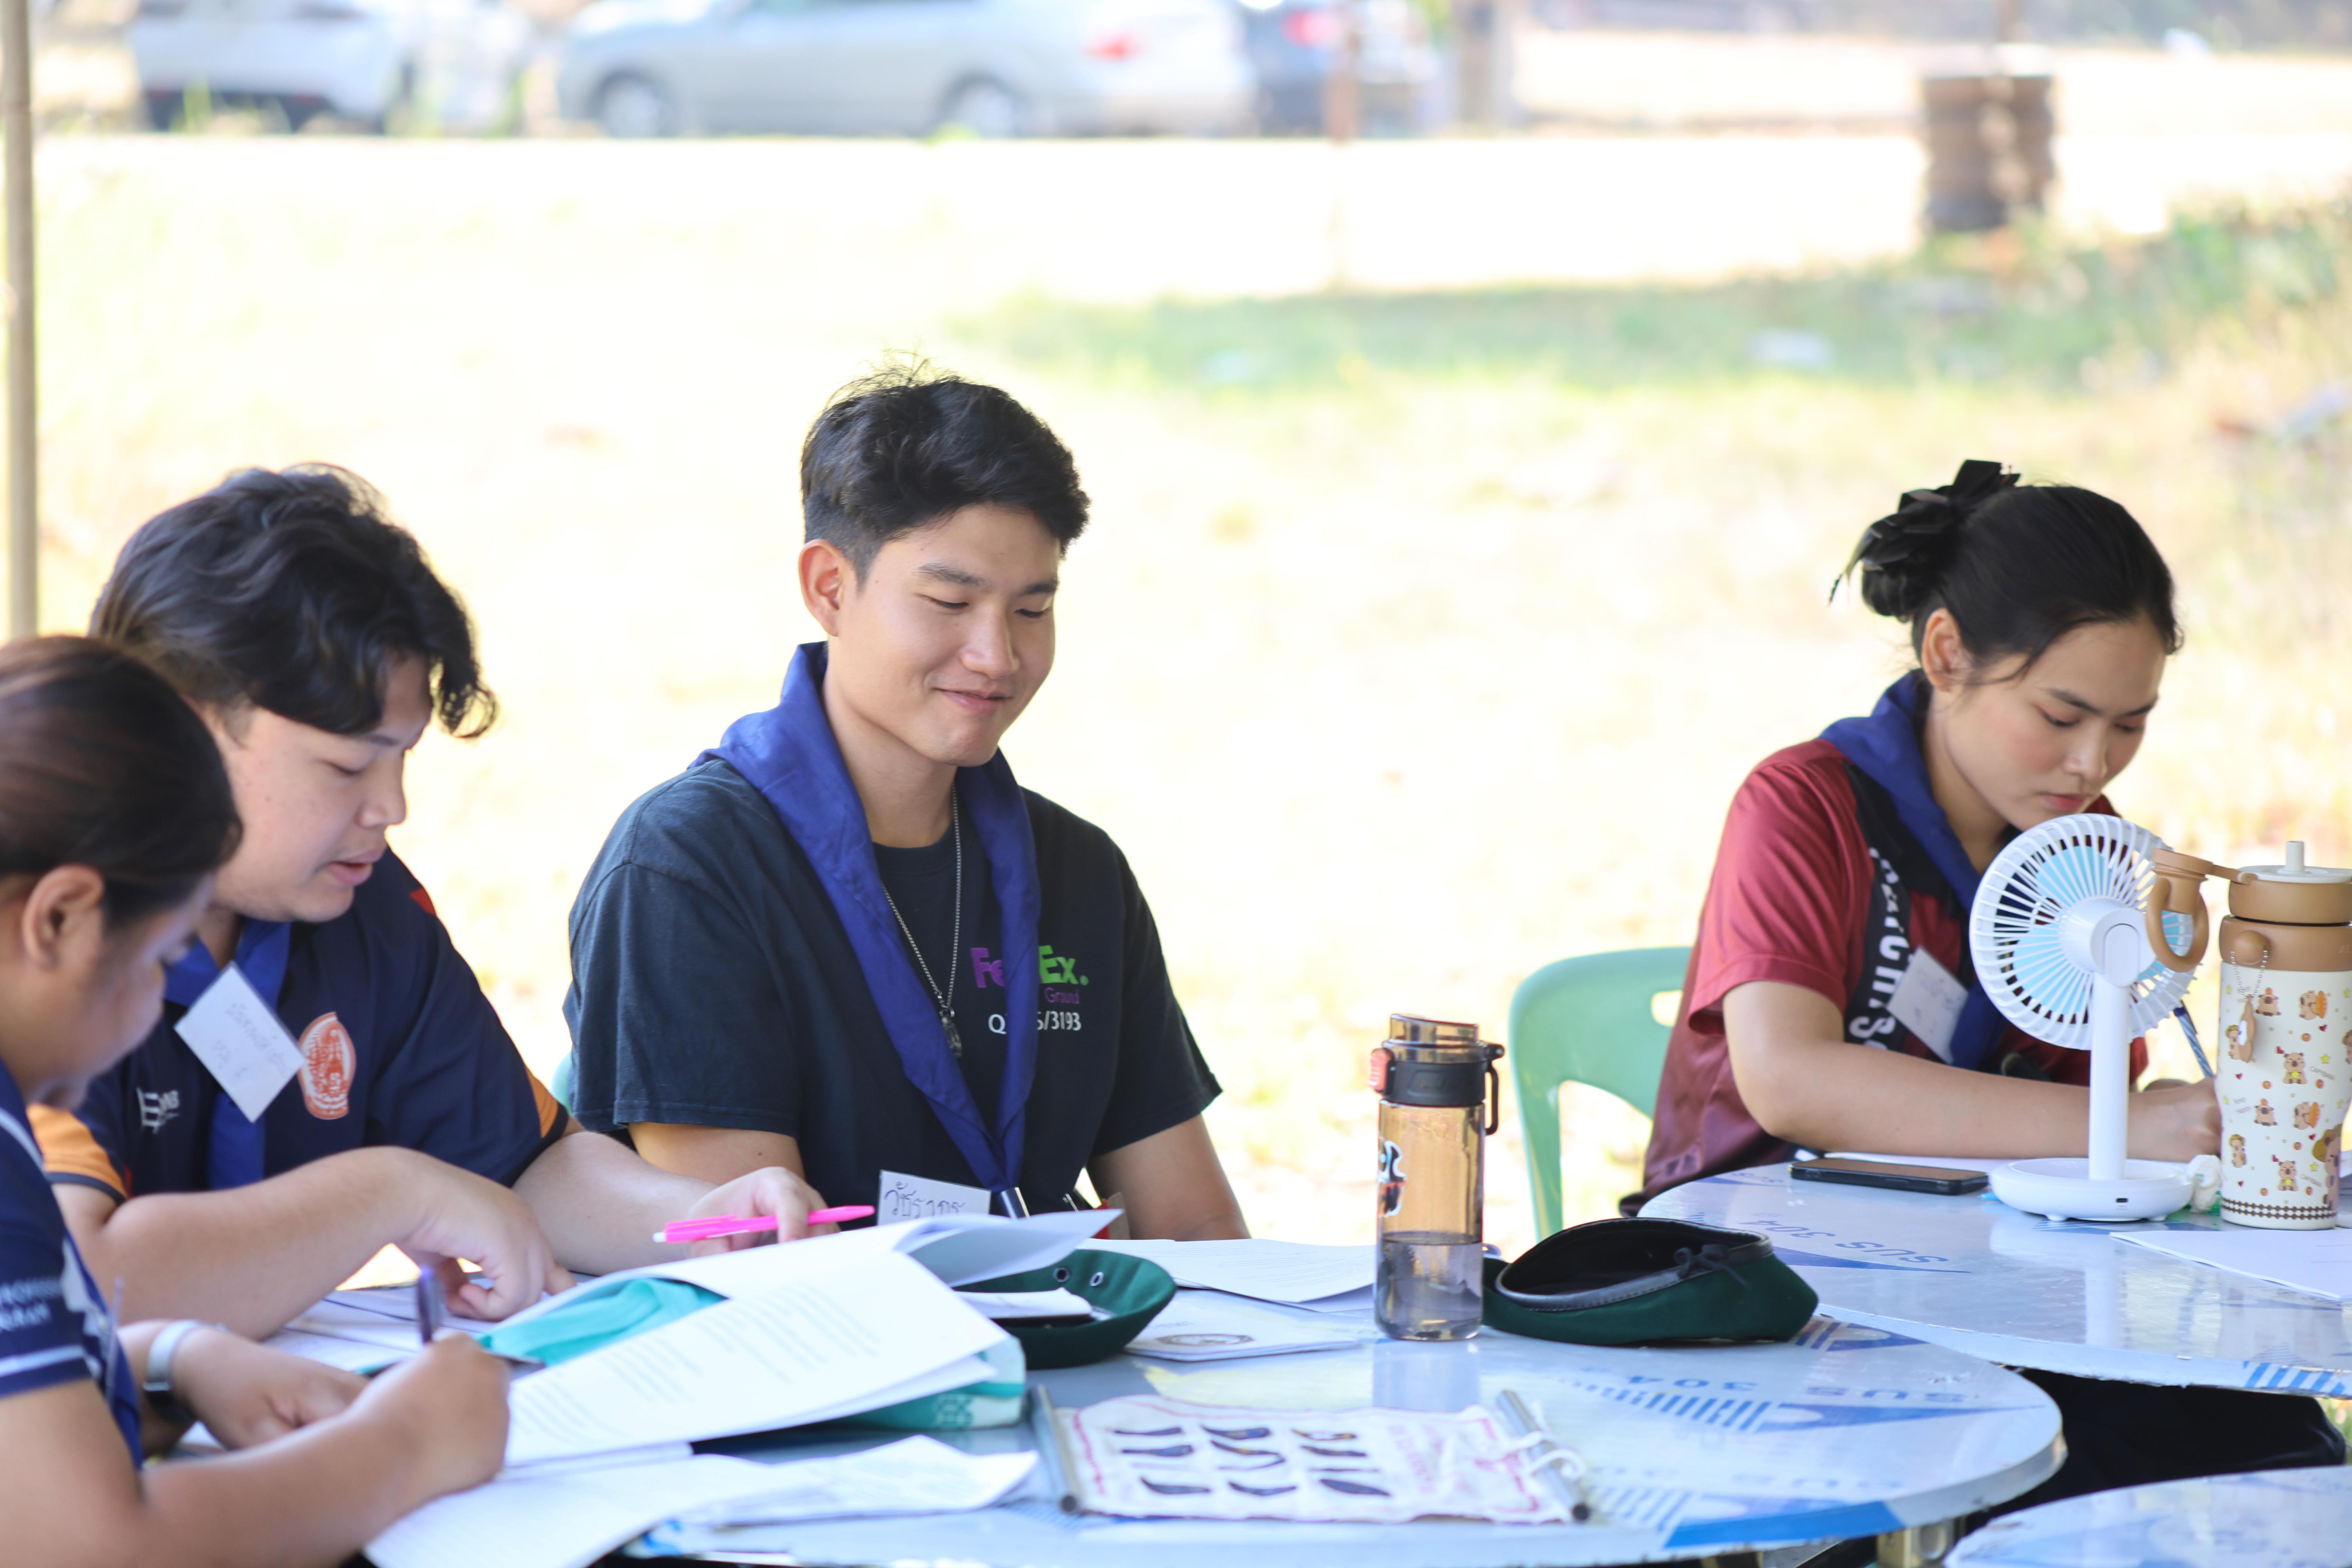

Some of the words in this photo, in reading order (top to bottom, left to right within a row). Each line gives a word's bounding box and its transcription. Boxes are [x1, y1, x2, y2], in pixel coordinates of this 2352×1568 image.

[1737, 1220, 1837, 1238] 304
[1835, 1241, 1950, 1263] SUS
[1626, 1374, 1759, 1392] 304
[1806, 1385, 1965, 1403] SUS
